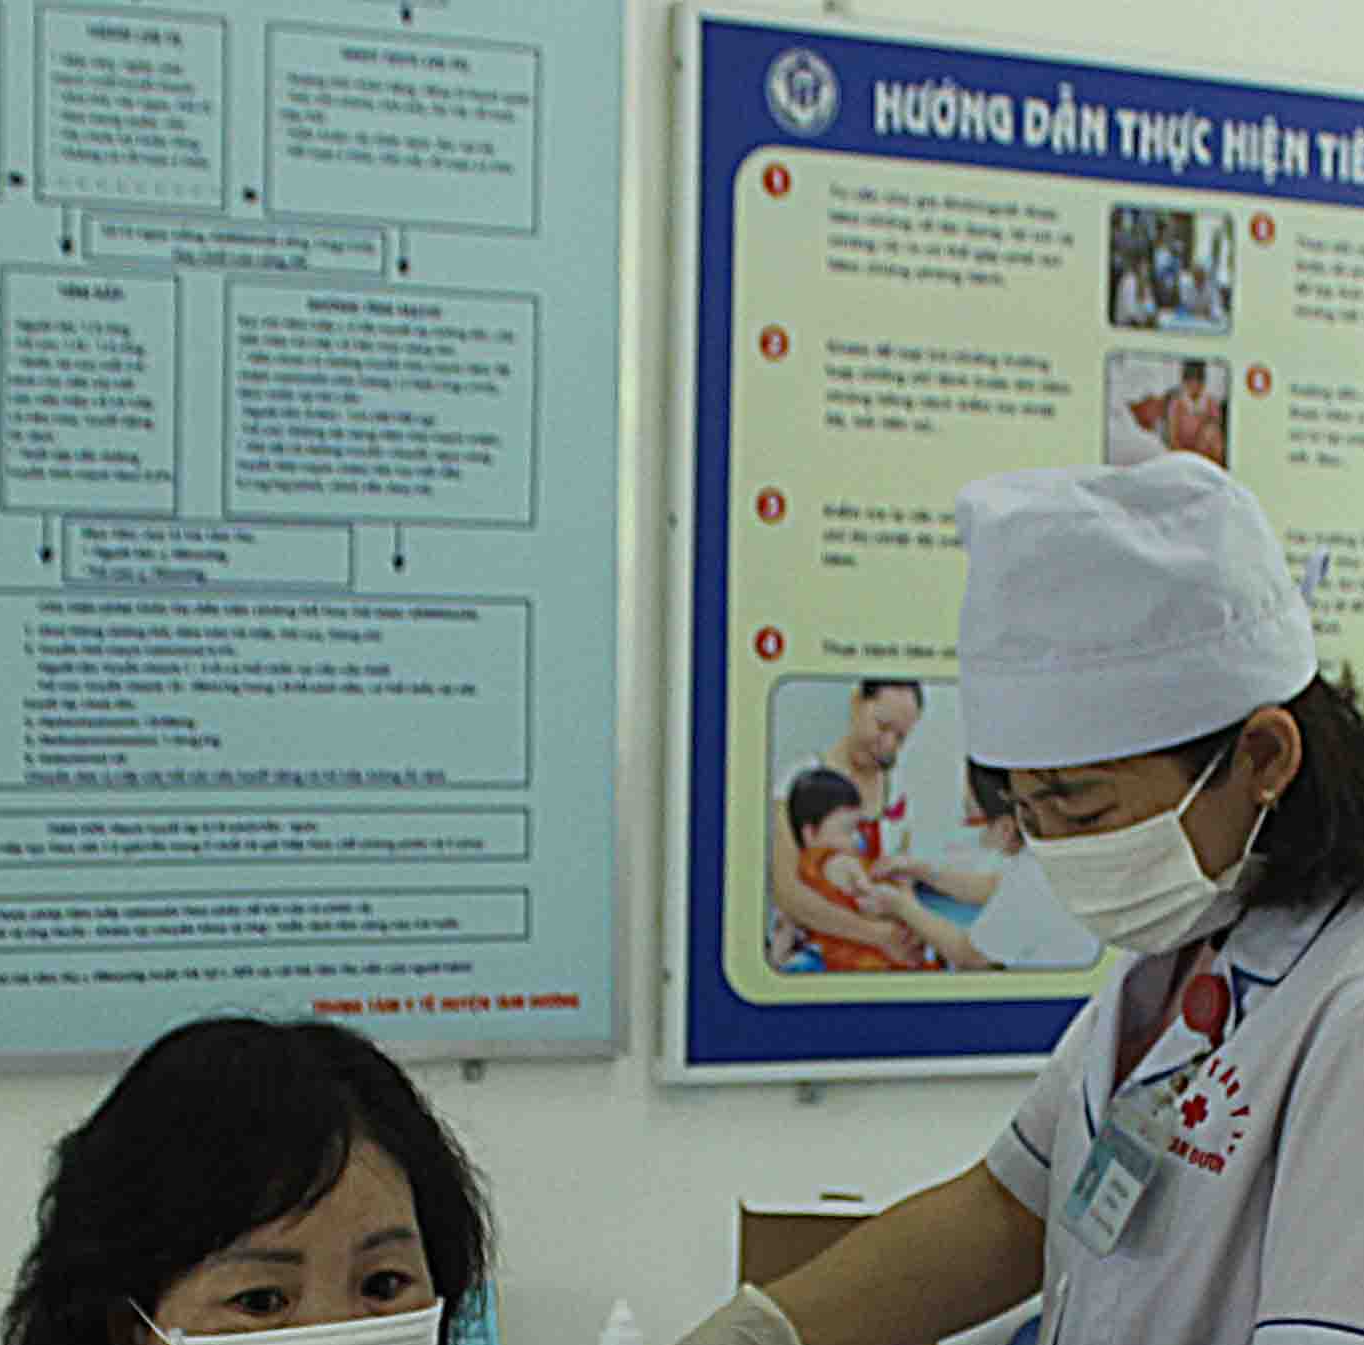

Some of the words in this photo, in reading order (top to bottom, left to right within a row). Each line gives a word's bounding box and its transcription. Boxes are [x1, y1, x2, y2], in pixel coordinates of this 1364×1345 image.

[874, 75, 1015, 145] HƯỚNG
[1023, 81, 1108, 155] DẪN
[1115, 106, 1212, 173] THỰC
[1221, 114, 1310, 186] HIỆN
